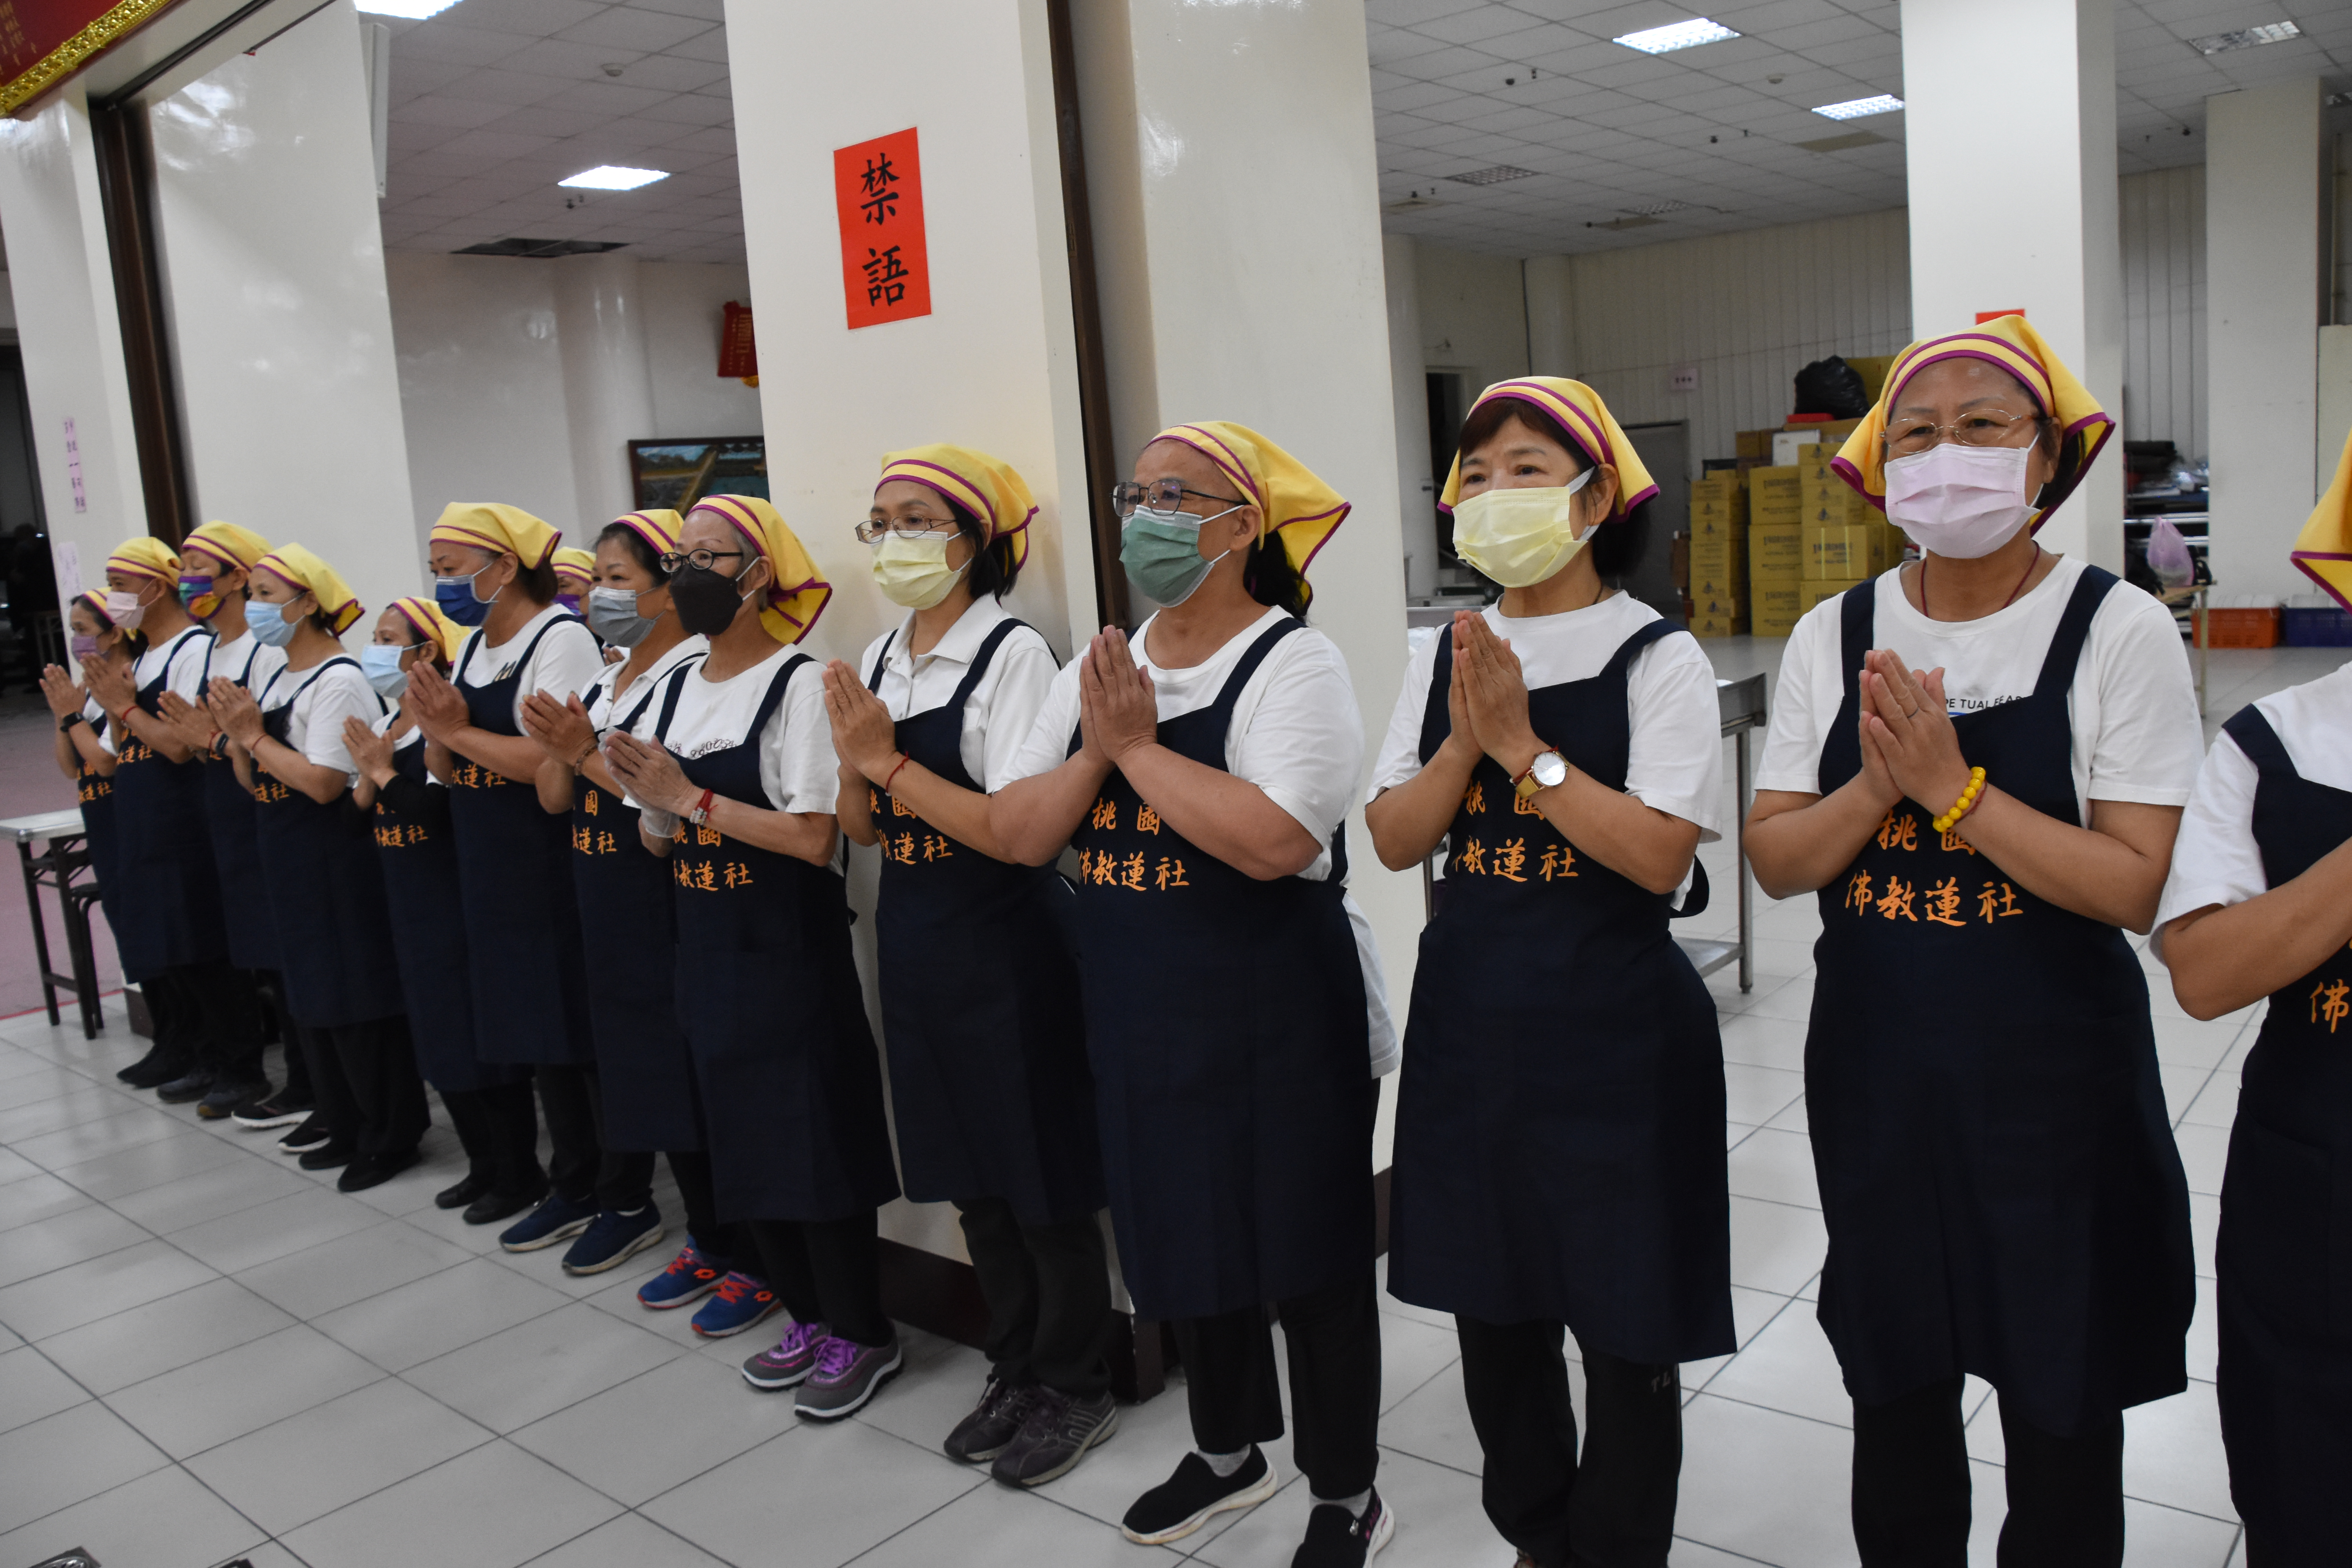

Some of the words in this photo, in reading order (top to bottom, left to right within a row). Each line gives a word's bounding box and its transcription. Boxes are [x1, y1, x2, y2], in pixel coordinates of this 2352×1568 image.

[860, 152, 909, 307] 禁語
[1078, 847, 1190, 891] 佛教蓮社
[1845, 869, 2024, 927] 佛教蓮社
[2310, 979, 2350, 1033] 佛
